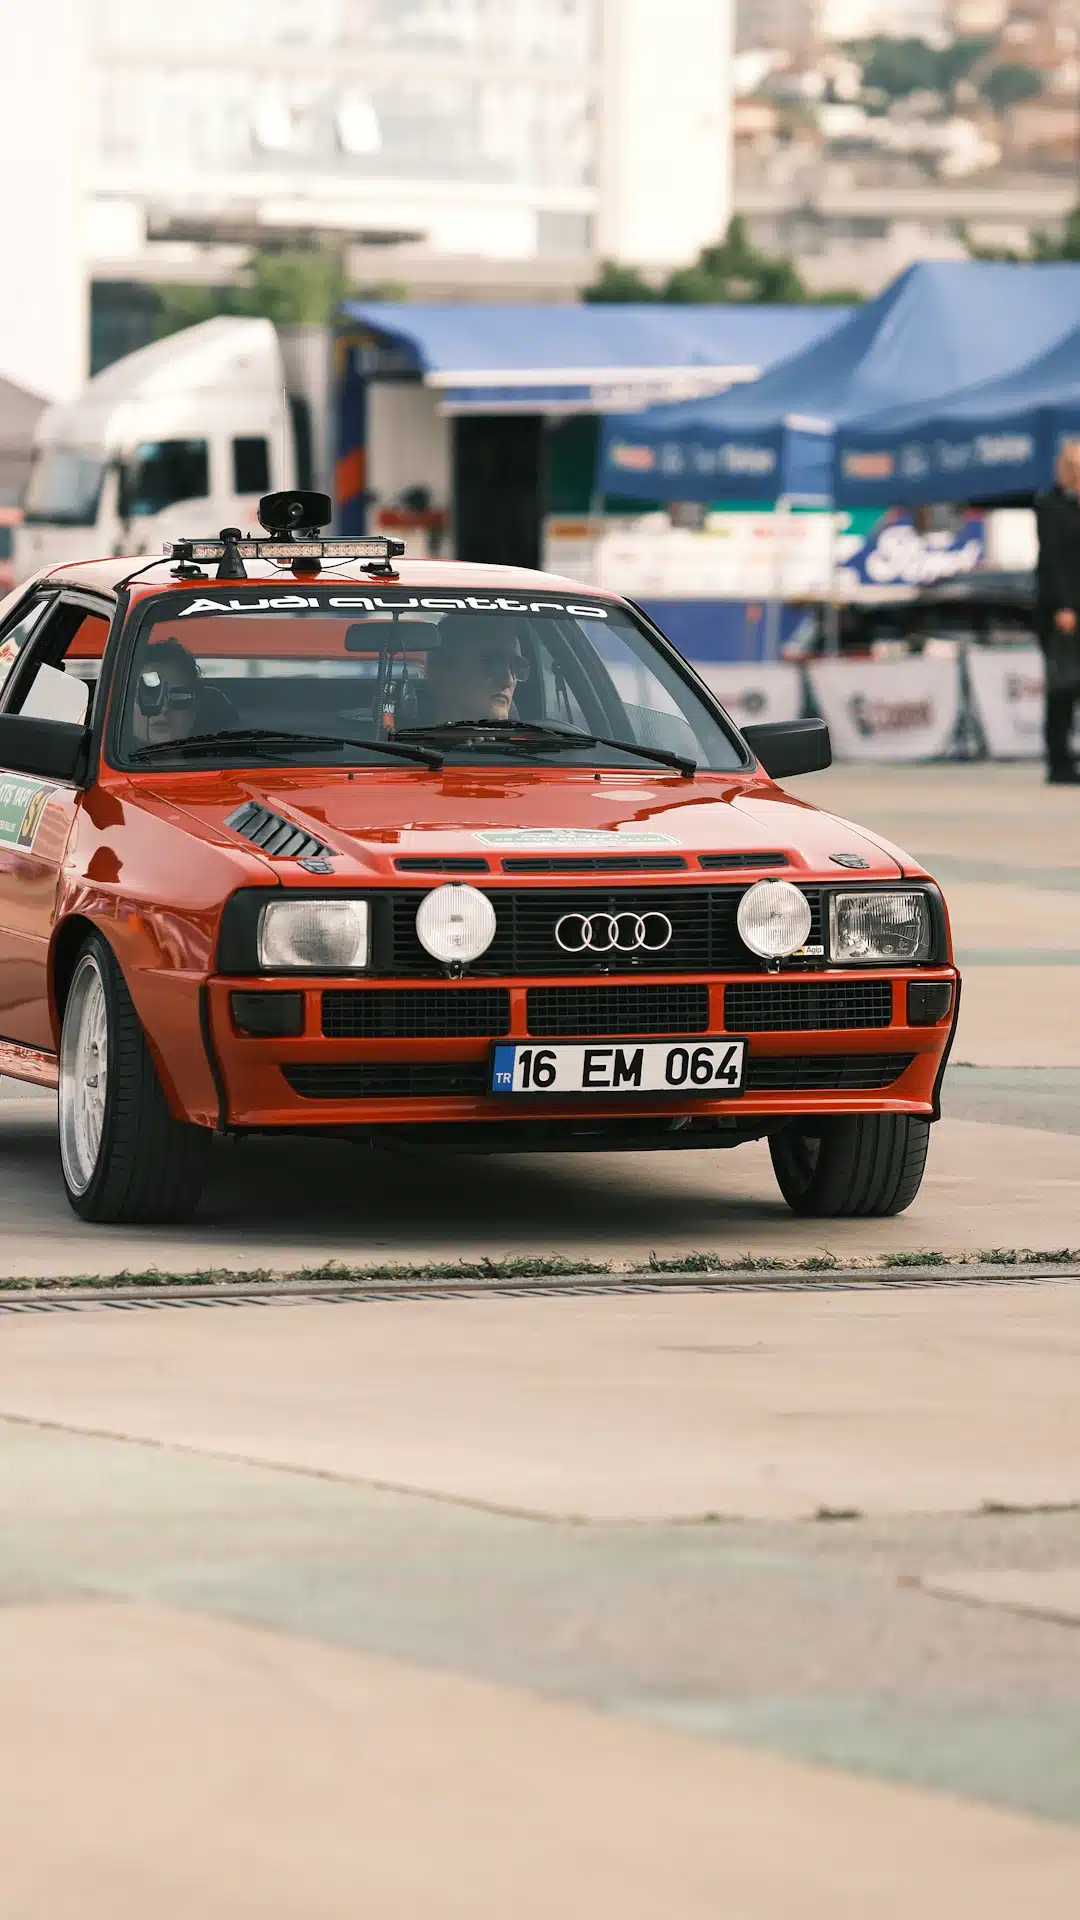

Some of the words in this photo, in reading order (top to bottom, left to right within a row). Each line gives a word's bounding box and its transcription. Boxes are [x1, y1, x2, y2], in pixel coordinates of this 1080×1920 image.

[178, 595, 319, 617] Audi
[328, 596, 609, 619] quattro
[806, 946, 822, 954] Agip
[496, 1072, 512, 1084] TR
[518, 1049, 557, 1088] 16
[582, 1048, 644, 1088] EM
[665, 1045, 738, 1085] 064
